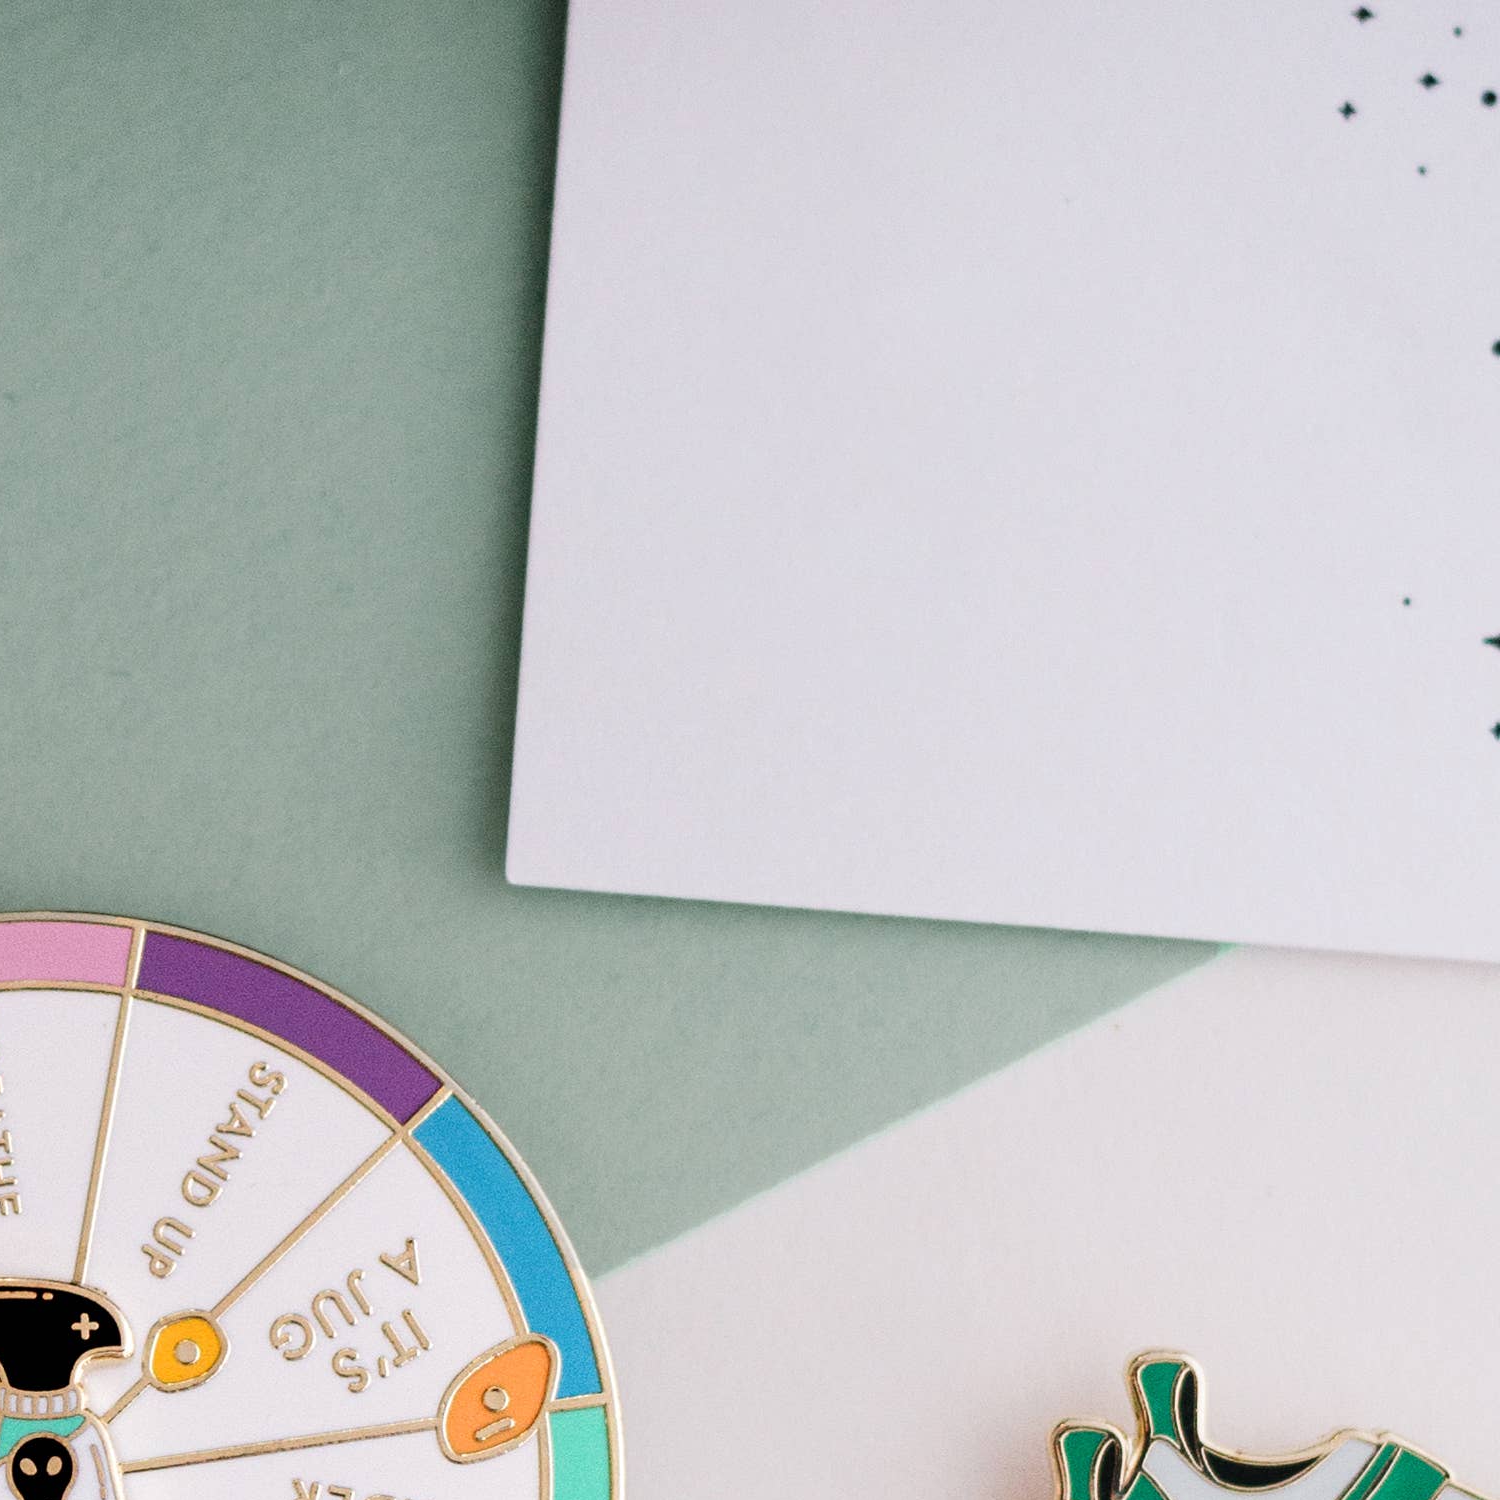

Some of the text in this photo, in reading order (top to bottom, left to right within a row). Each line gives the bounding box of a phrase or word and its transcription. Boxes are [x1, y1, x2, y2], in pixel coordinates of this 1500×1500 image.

[140, 1061, 288, 1278] STAND UP
[269, 1237, 422, 1361] A JUG
[332, 1309, 433, 1393] IT'S
